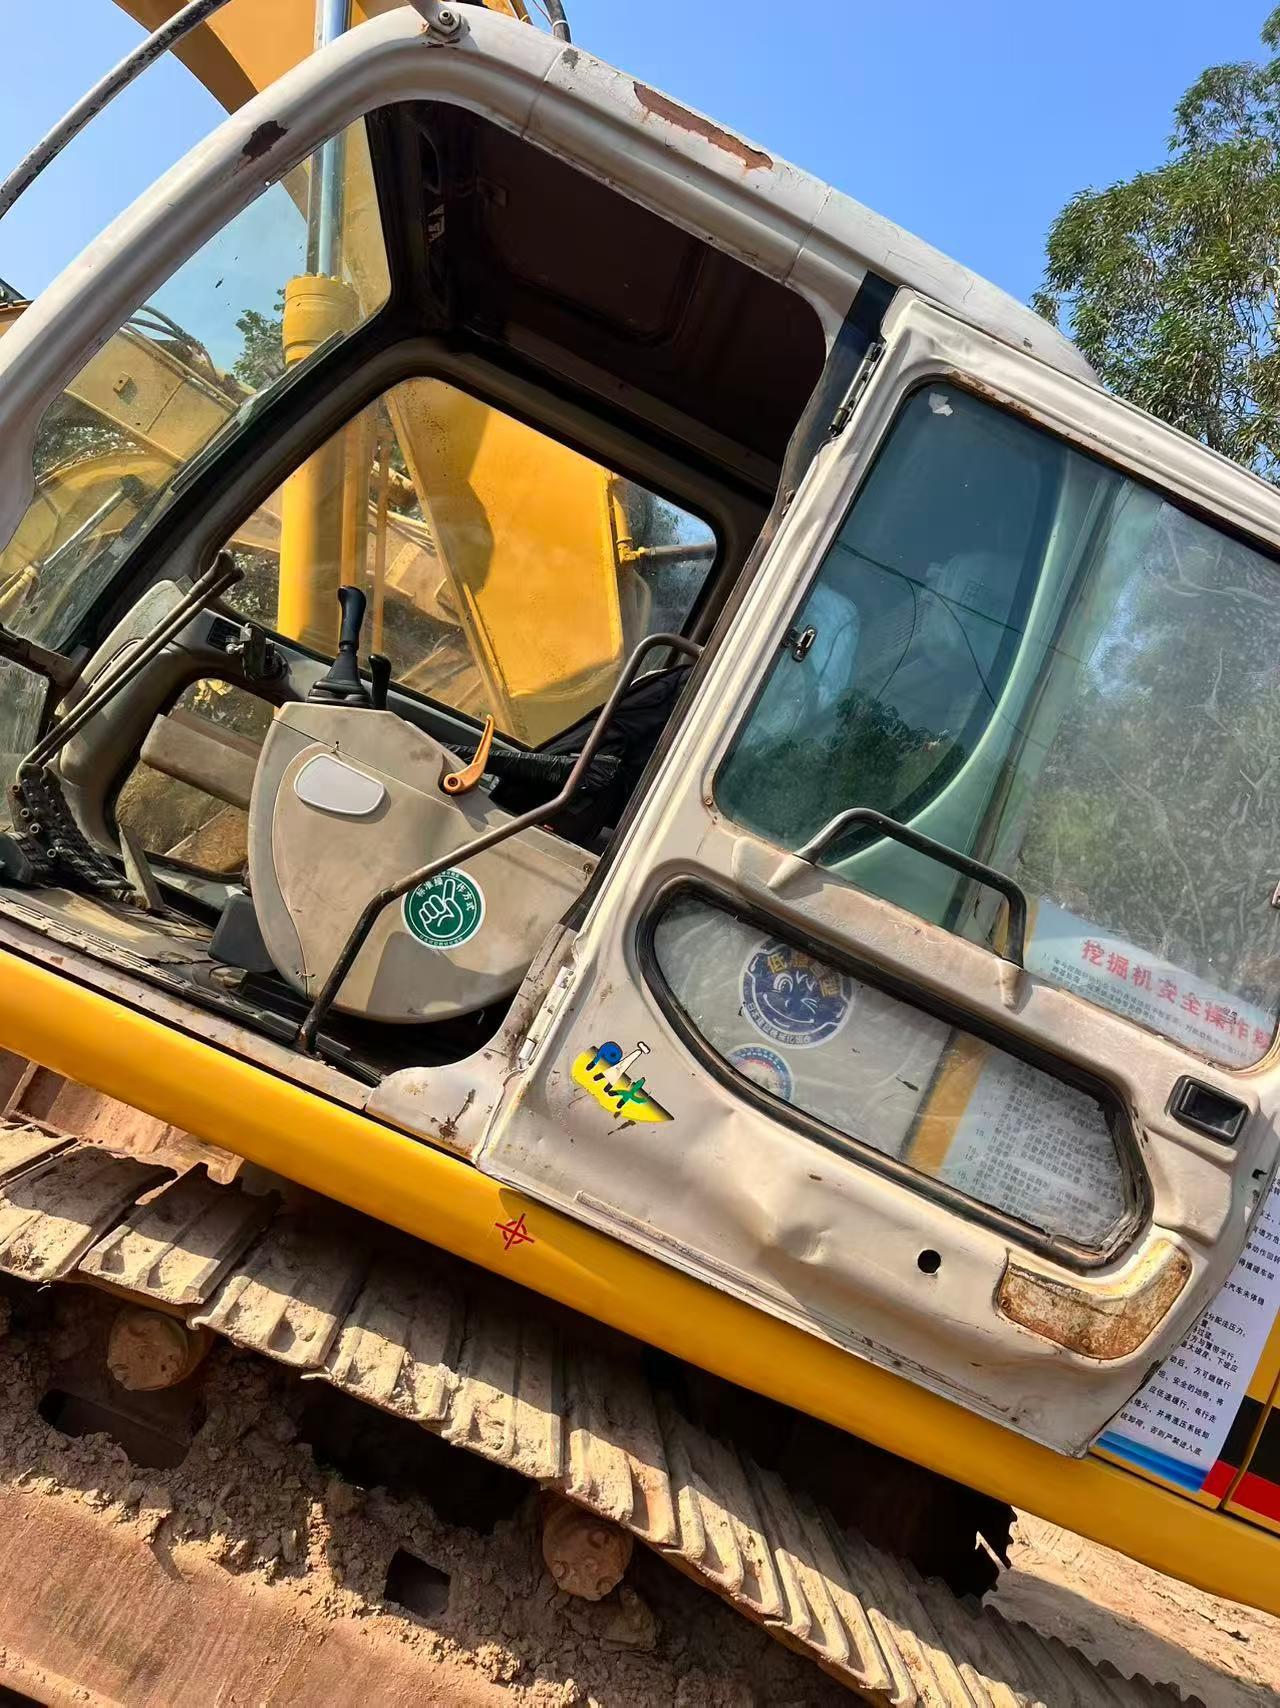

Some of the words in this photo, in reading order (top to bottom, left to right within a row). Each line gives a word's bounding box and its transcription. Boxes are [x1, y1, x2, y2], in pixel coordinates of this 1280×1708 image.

[1129, 1398, 1211, 1439] 熄火，并将液压系统卸
